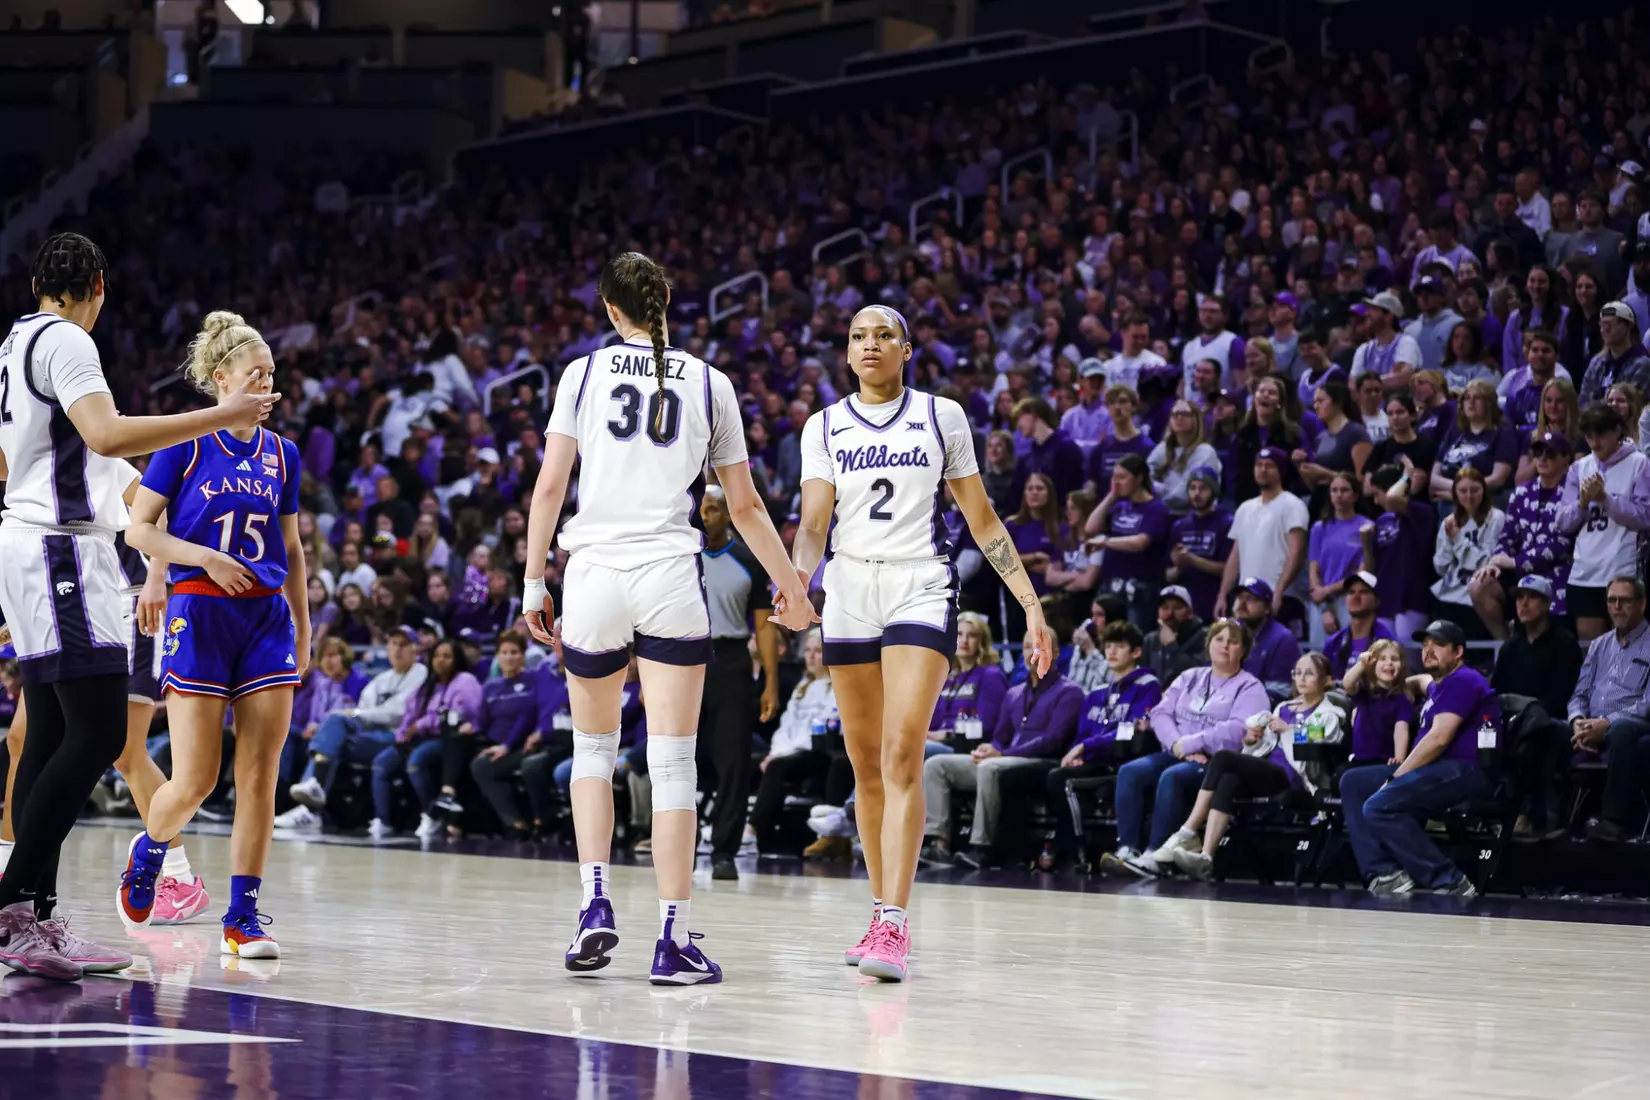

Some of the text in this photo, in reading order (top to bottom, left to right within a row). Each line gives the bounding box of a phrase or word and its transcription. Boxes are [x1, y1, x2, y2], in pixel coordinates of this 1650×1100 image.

[610, 354, 686, 381] SANCEZ
[607, 382, 683, 448] 30
[836, 444, 930, 474] Wildcats
[869, 477, 895, 522] 2
[213, 510, 270, 563] 15
[1478, 849, 1493, 860] 30
